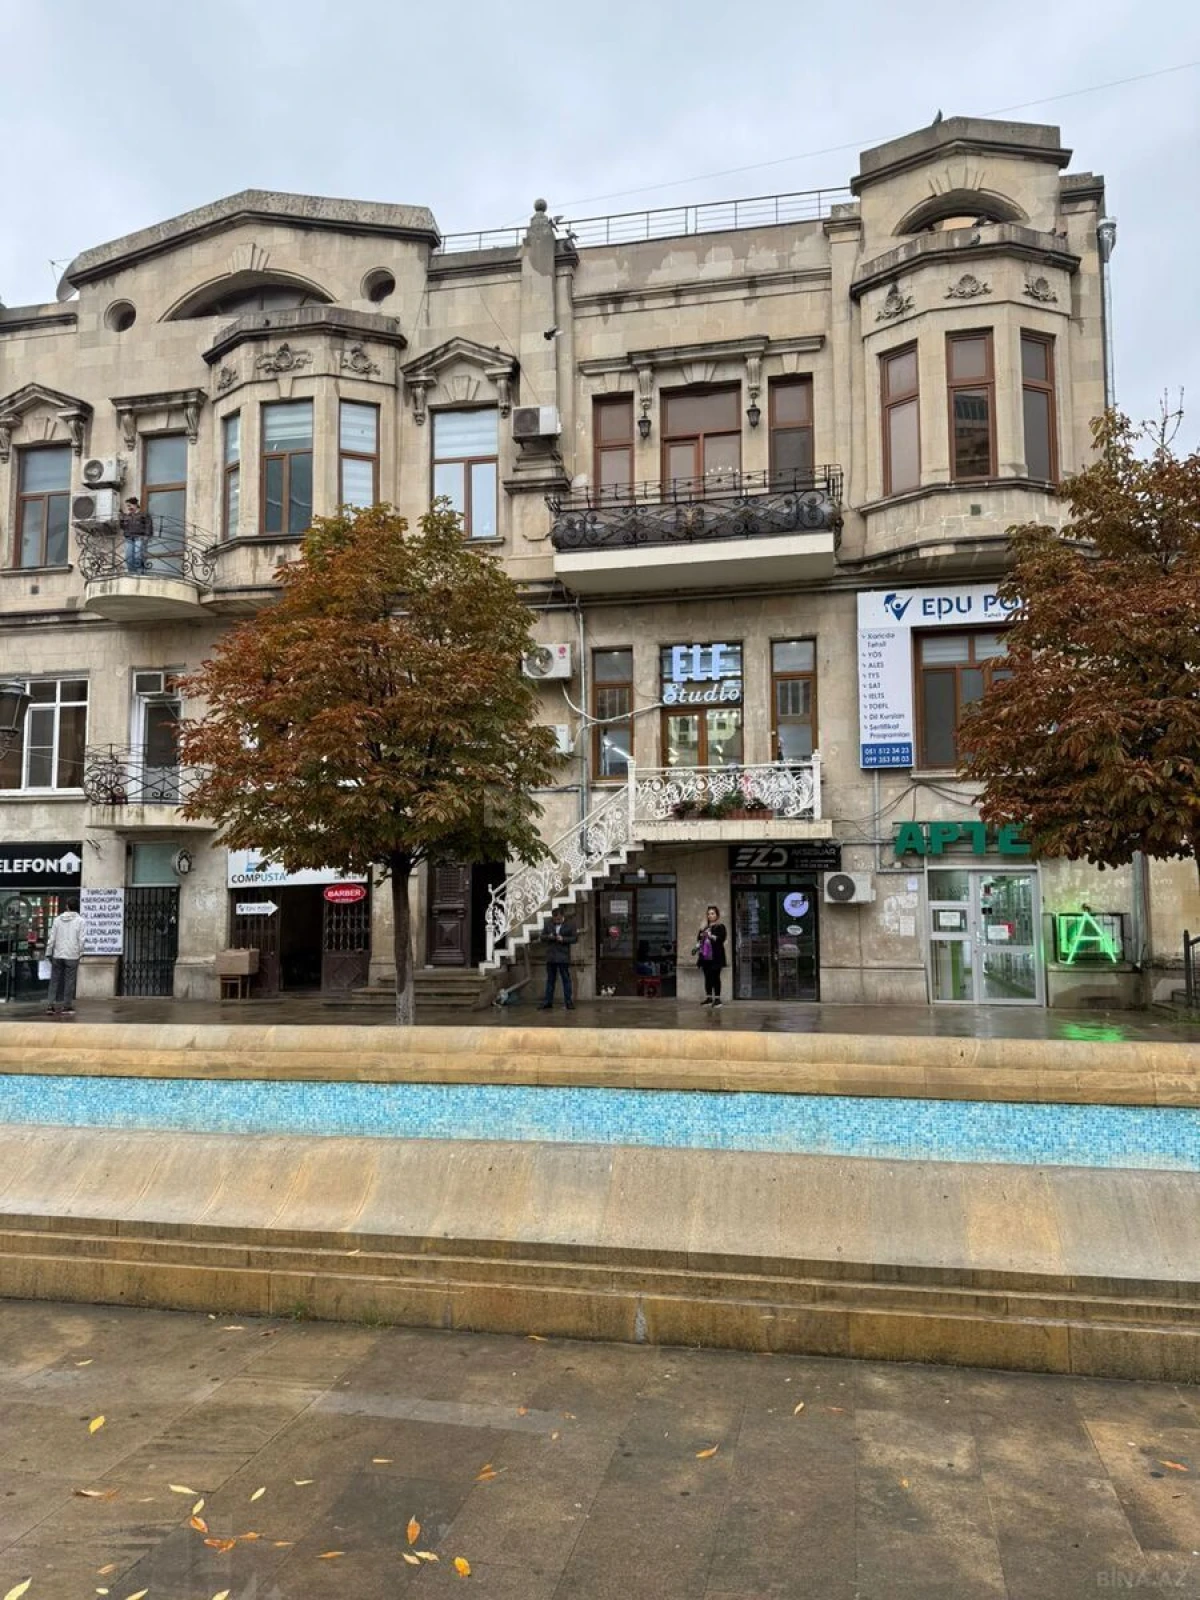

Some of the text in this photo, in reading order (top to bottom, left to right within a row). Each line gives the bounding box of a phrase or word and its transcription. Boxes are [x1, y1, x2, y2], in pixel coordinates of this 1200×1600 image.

[922, 595, 972, 620] EDU
[663, 683, 741, 705] Studio
[868, 692, 885, 700] IELTS
[327, 888, 361, 898] BARBER
